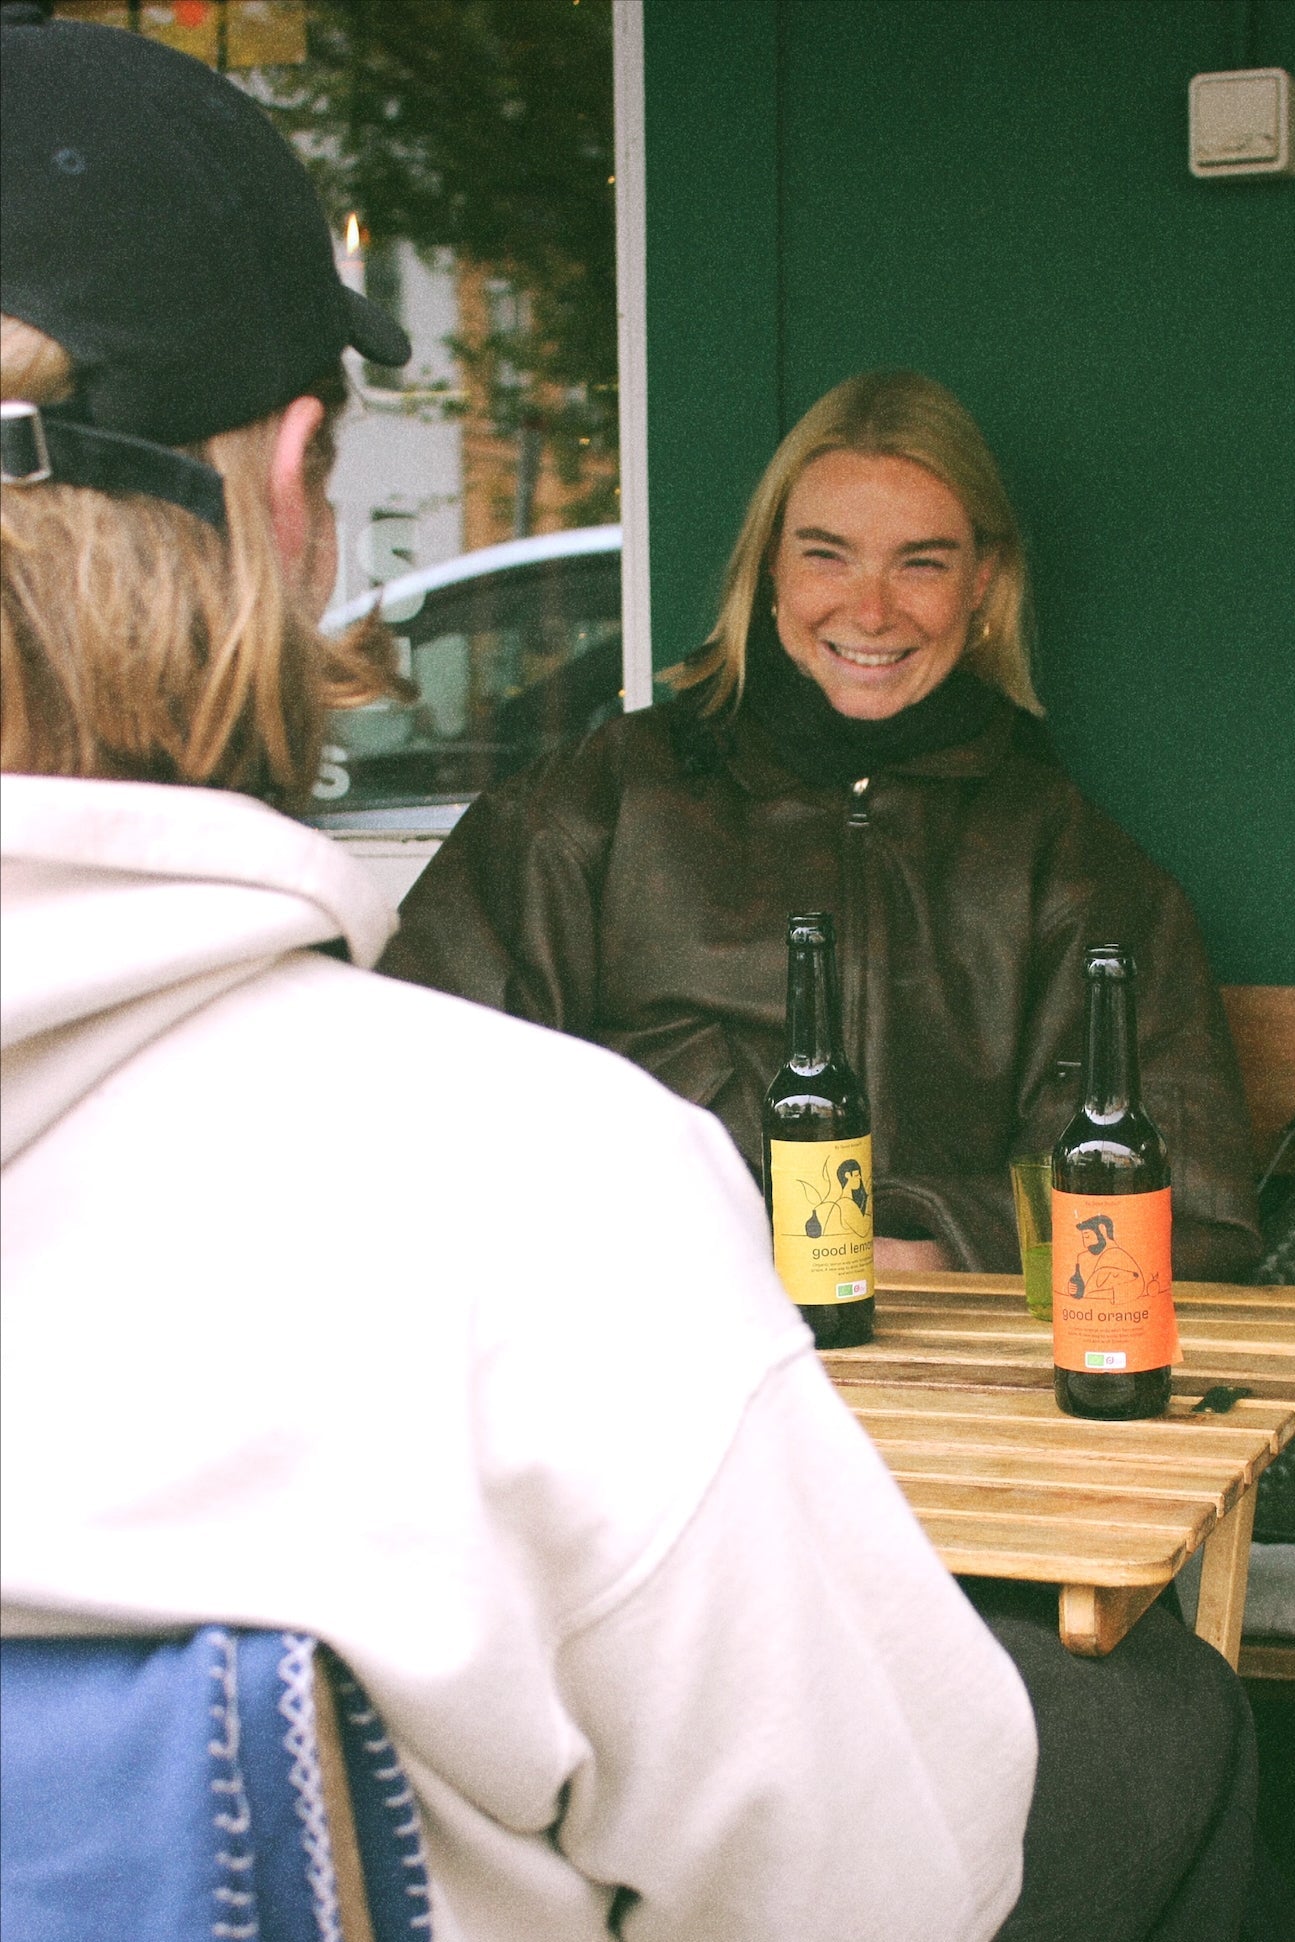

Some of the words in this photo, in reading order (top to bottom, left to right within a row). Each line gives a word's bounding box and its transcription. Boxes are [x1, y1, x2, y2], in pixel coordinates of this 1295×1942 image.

[812, 1243, 847, 1260] good
[850, 1241, 873, 1254] lemo
[1062, 1308, 1093, 1321] good
[1097, 1310, 1149, 1323] orange
